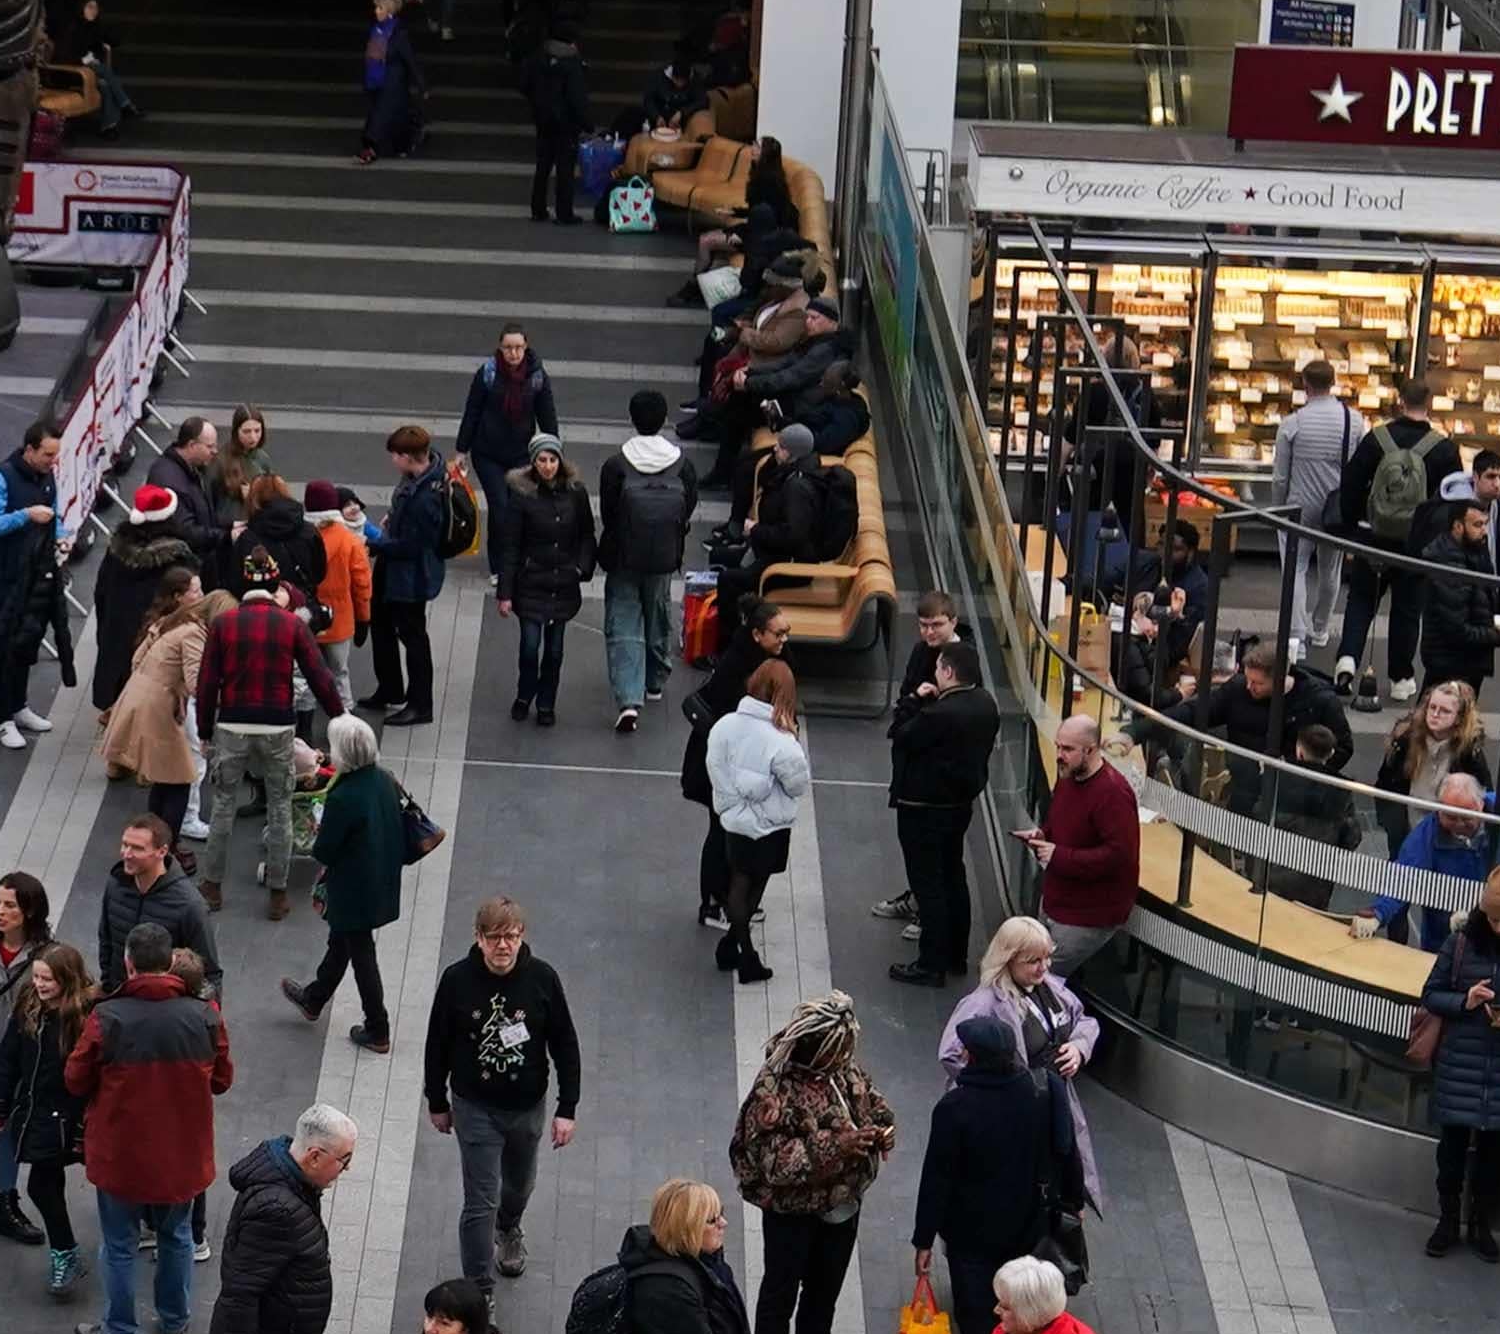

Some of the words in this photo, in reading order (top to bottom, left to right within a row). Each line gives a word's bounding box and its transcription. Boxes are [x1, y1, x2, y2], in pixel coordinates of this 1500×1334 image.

[1386, 67, 1494, 136] PRET
[1045, 169, 1147, 204] Organic
[1157, 174, 1233, 209] Coffee
[1266, 182, 1335, 208] Good
[1343, 185, 1405, 212] Food
